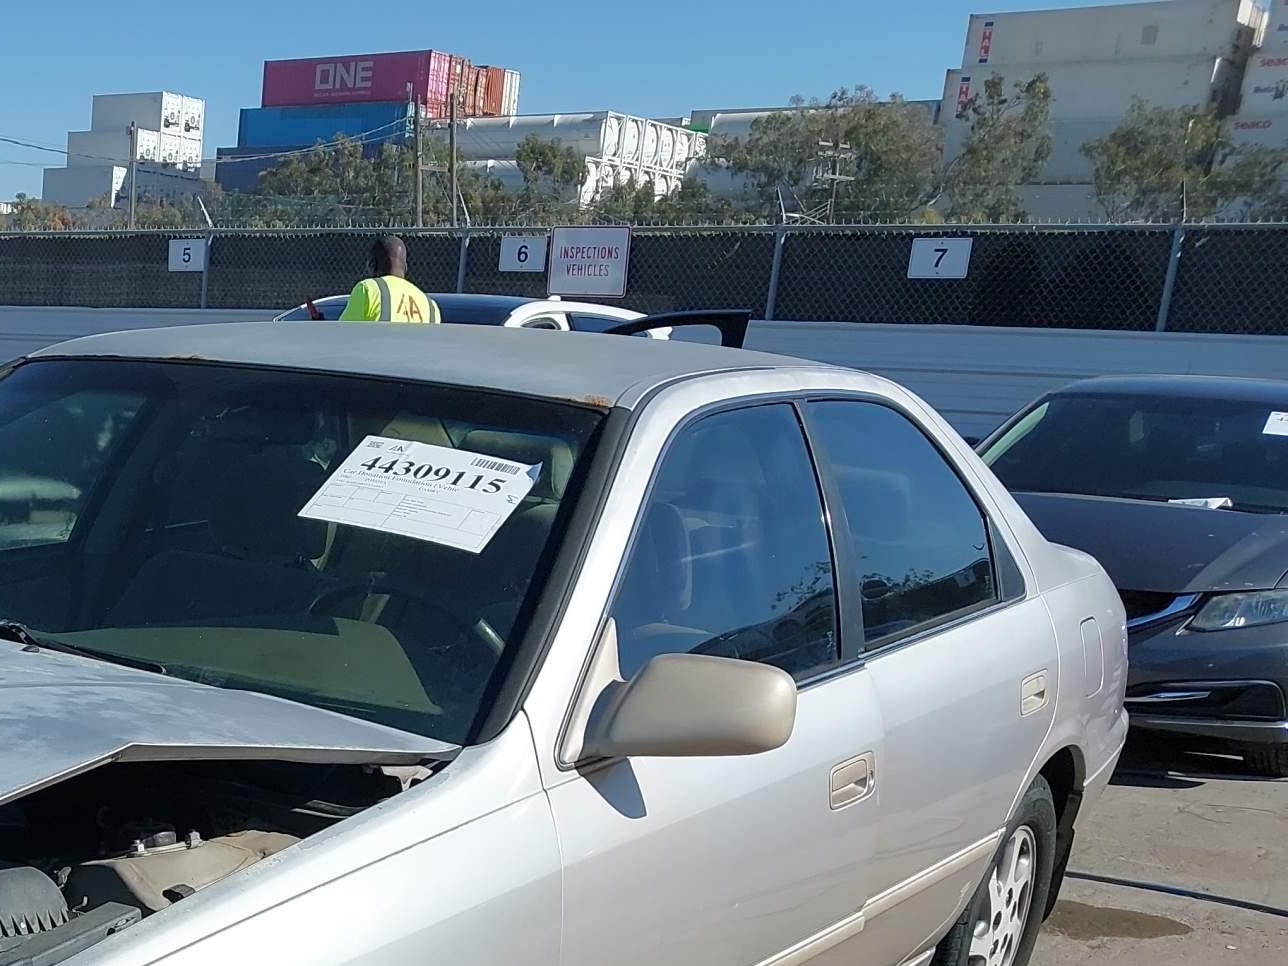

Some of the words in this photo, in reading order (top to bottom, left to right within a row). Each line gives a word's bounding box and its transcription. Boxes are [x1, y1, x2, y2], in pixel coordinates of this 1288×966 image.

[314, 61, 374, 90] ONE
[182, 247, 192, 263] 5
[517, 245, 529, 263] 6
[559, 246, 619, 259] INSPECTIONS
[933, 248, 949, 268] 7
[566, 263, 609, 276] VEHICLES
[361, 456, 507, 493] 44309115
